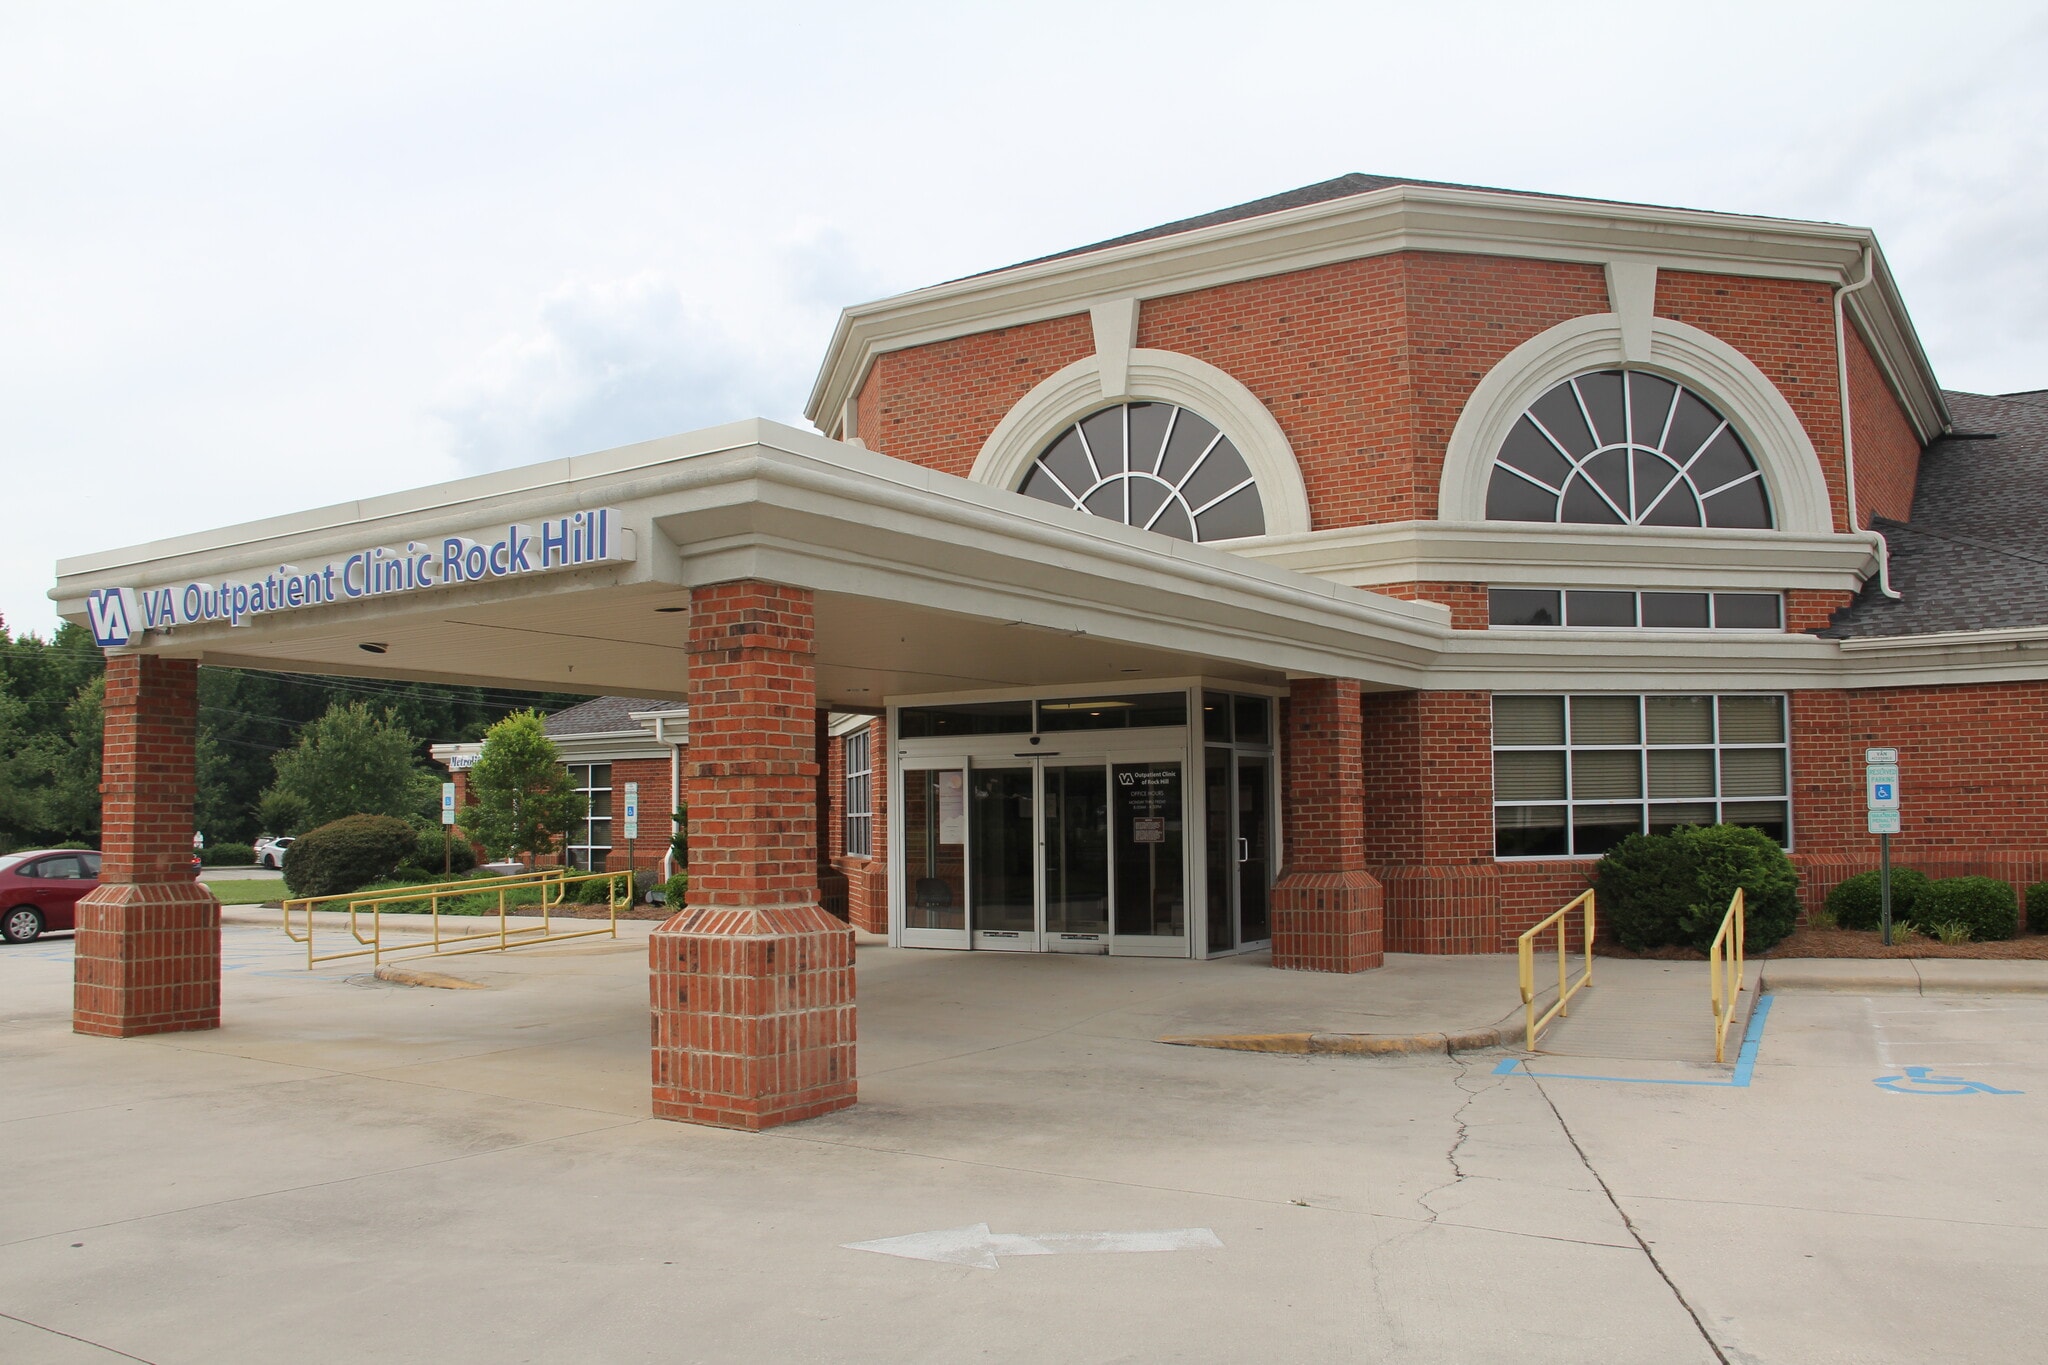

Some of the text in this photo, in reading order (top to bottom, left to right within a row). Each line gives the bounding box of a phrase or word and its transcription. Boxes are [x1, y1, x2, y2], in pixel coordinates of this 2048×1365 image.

[143, 588, 177, 628] VA
[183, 564, 336, 628] Outpatient
[343, 541, 433, 598] Clinic
[443, 525, 532, 583] Rock
[542, 509, 608, 568] Hill
